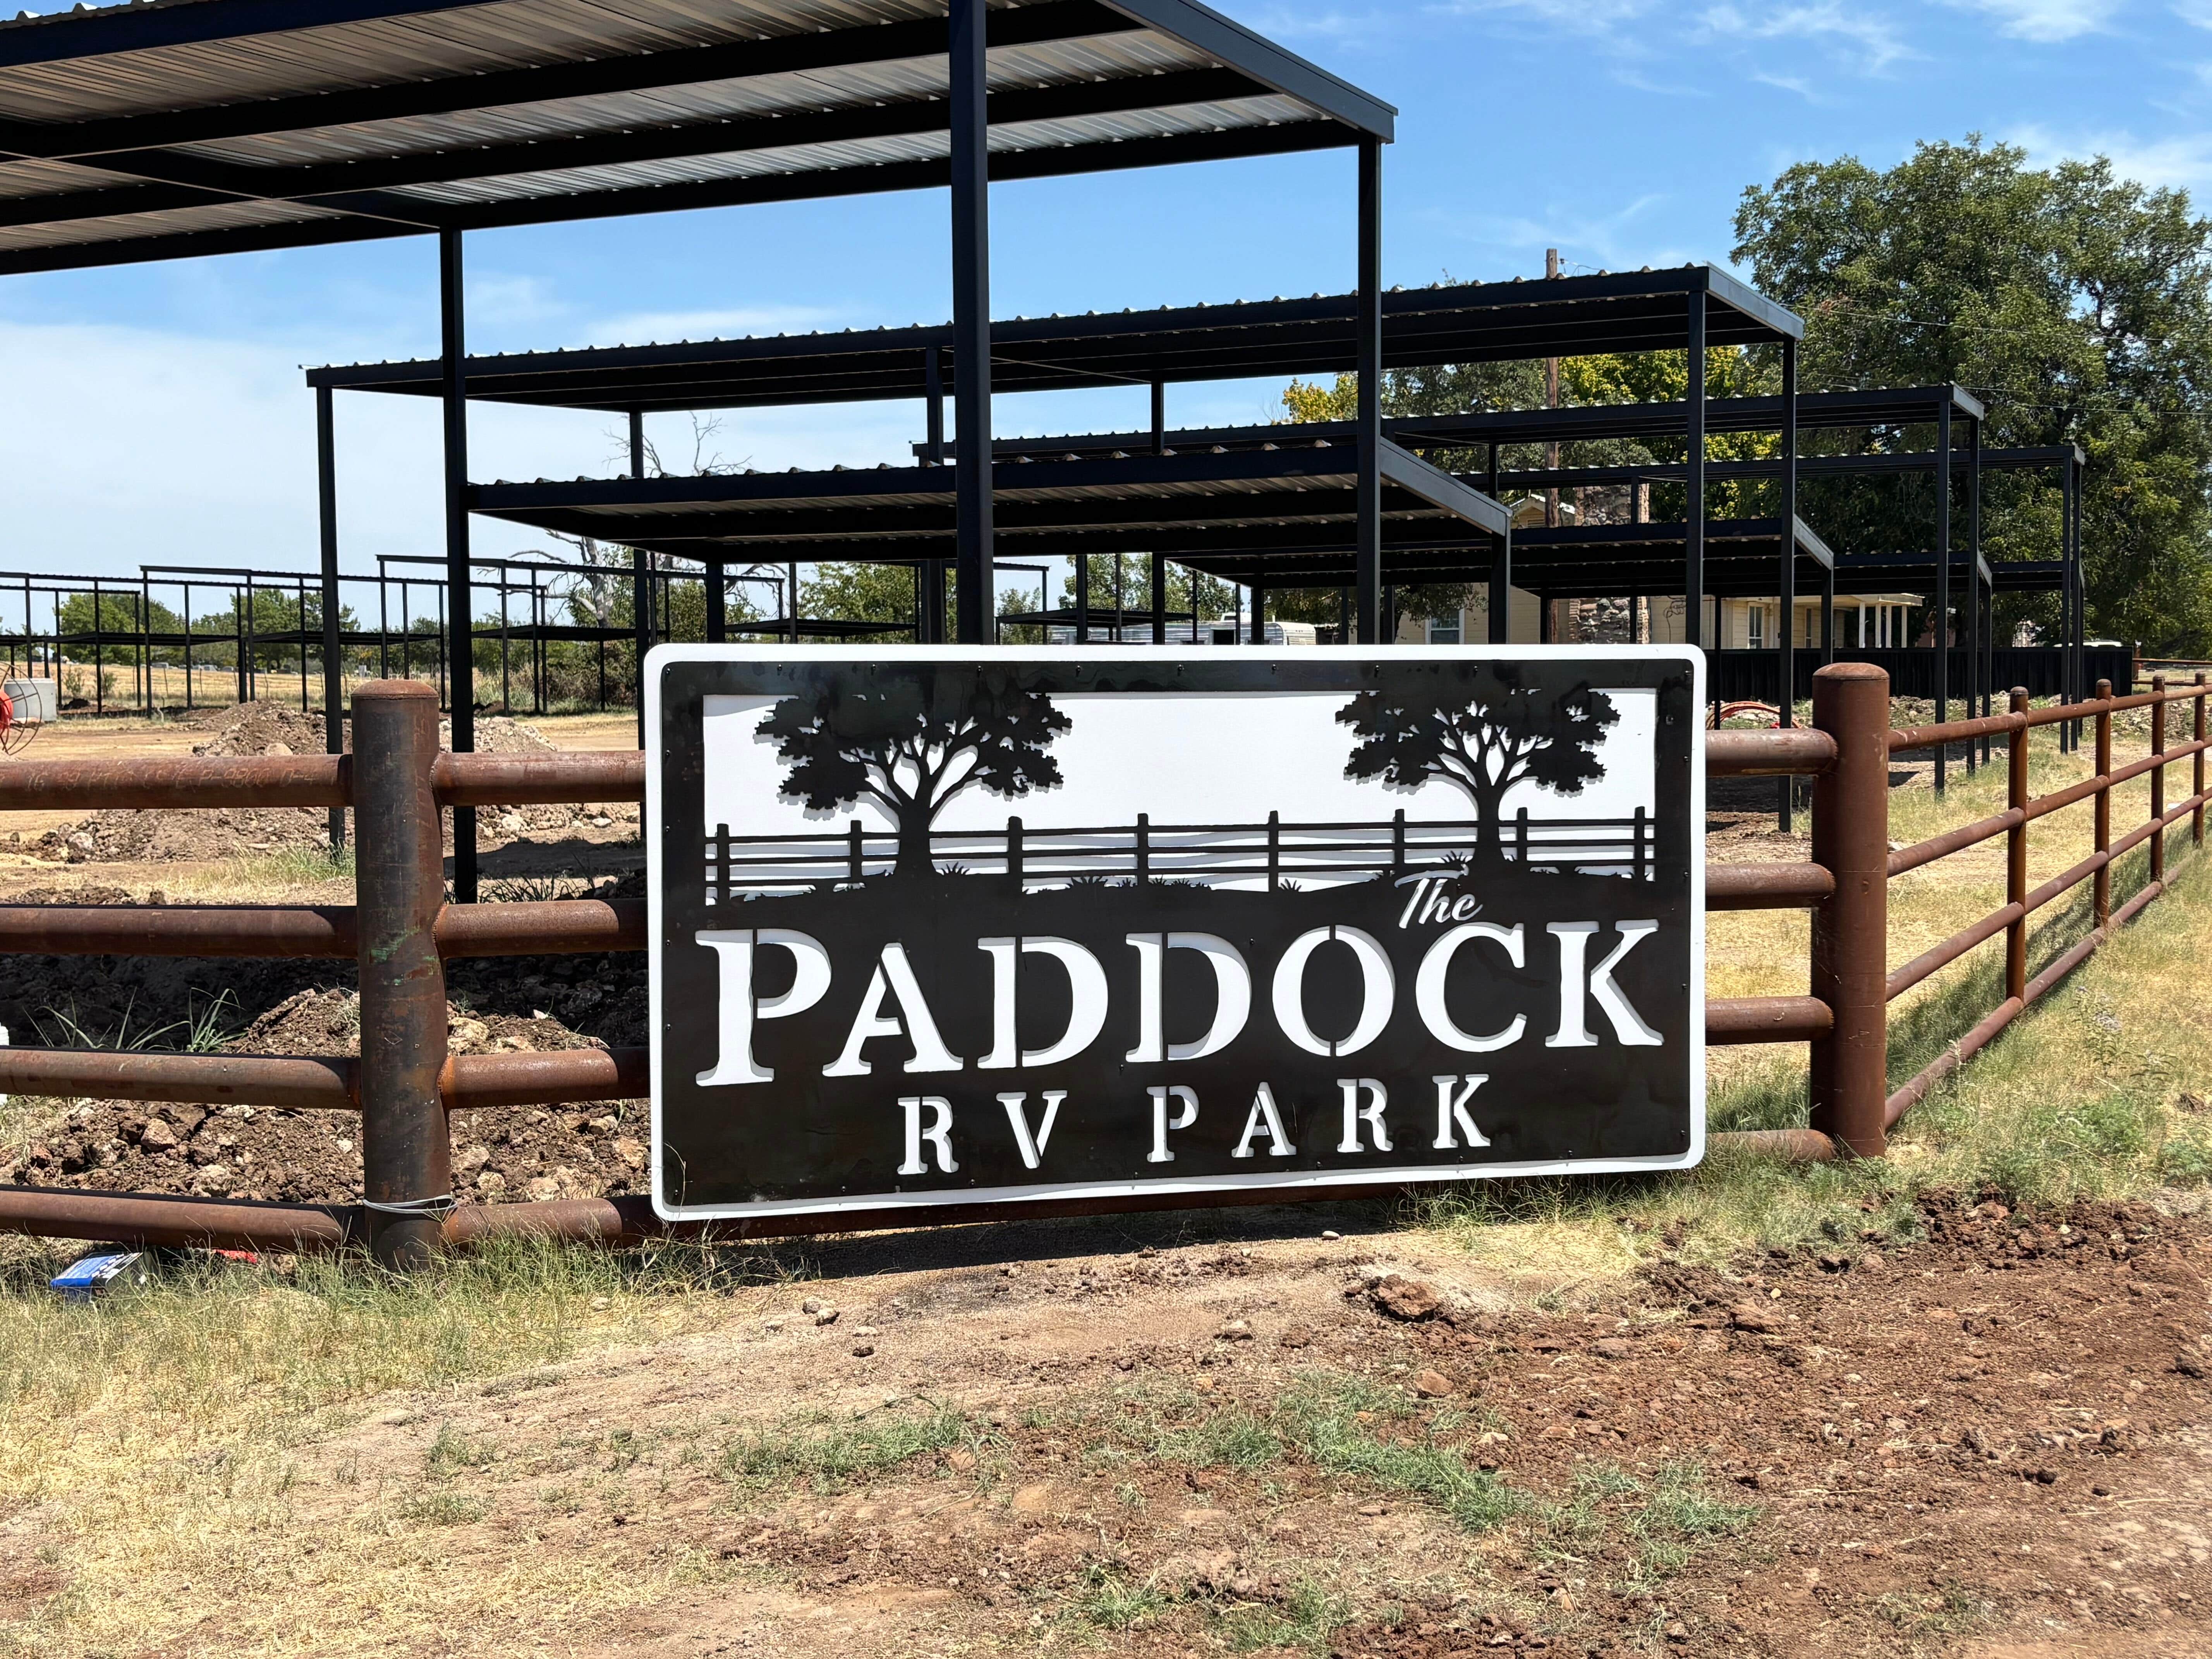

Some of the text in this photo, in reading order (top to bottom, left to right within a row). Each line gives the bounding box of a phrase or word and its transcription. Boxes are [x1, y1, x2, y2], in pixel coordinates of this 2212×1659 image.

[1394, 863, 1483, 929] The
[695, 919, 1664, 1087] PADDOCK
[897, 1073, 1491, 1175] RV PARK
